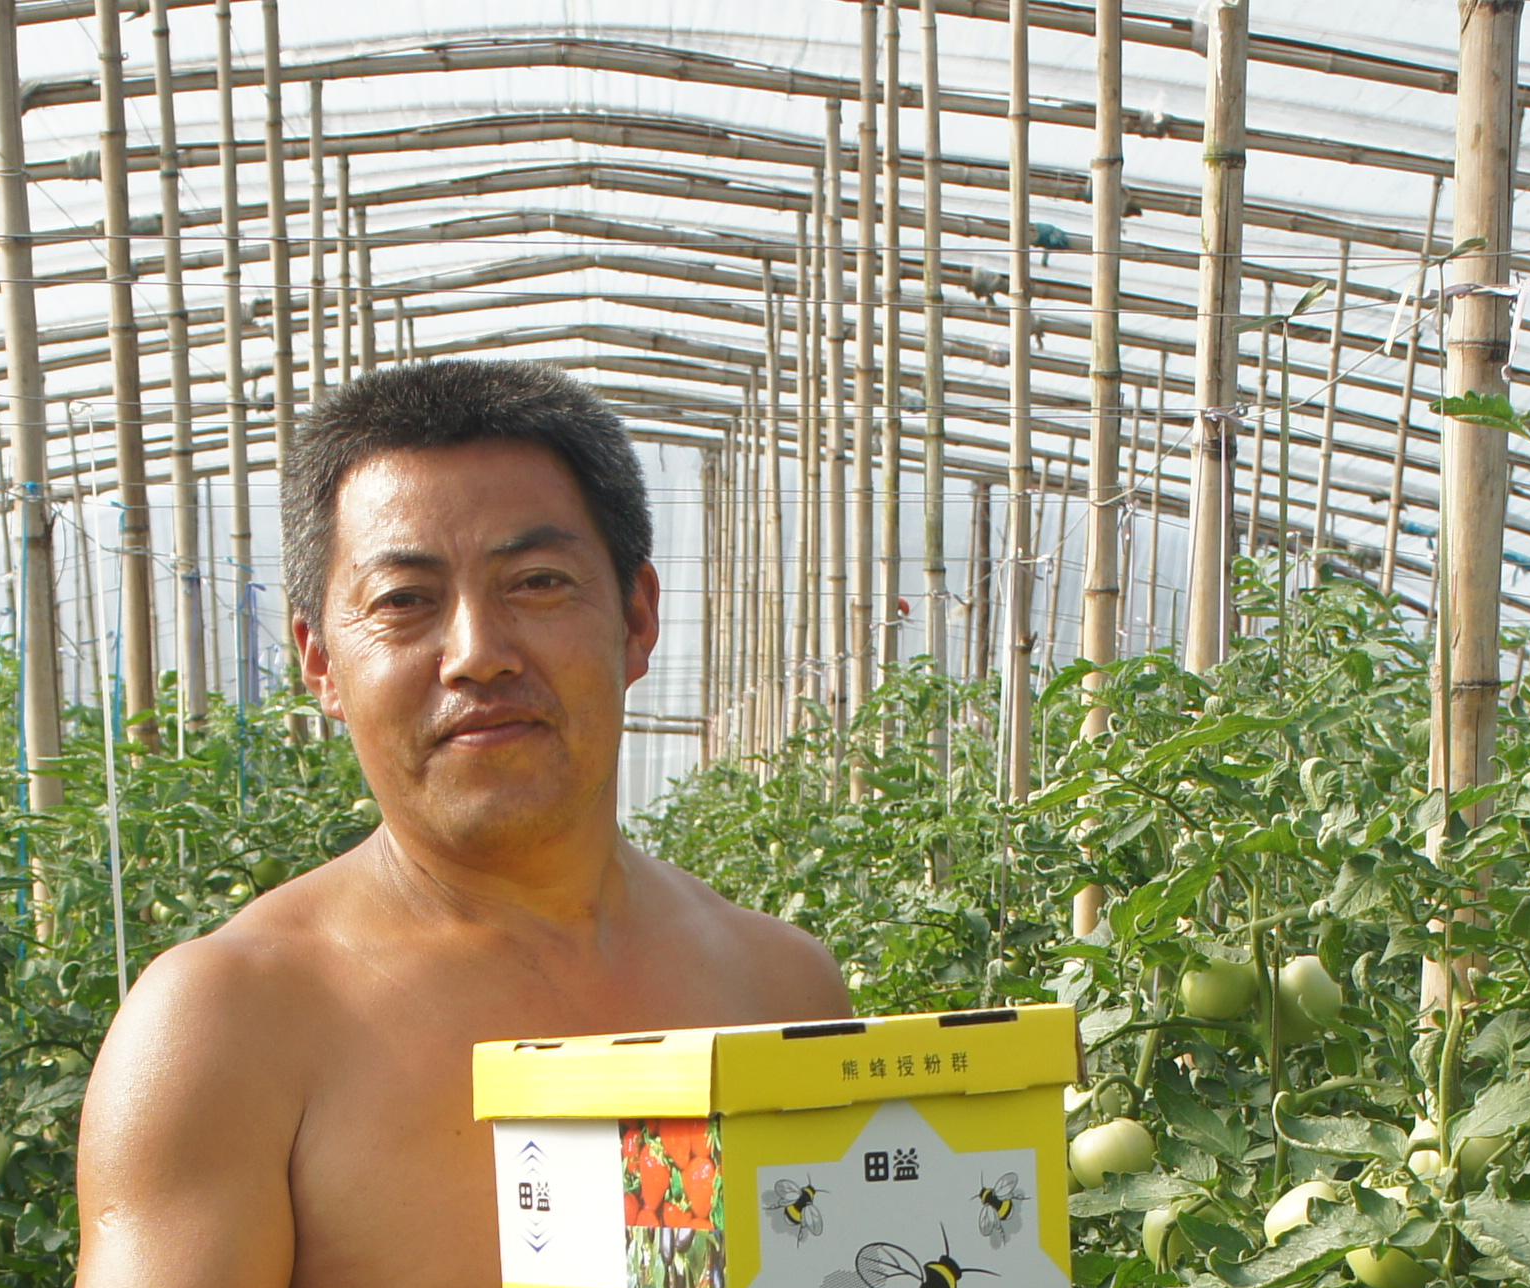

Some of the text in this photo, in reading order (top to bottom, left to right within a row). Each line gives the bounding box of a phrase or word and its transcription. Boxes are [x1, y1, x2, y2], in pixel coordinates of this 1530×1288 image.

[842, 1052, 968, 1081] 熊蜂授粉群
[864, 1147, 920, 1182] 田益
